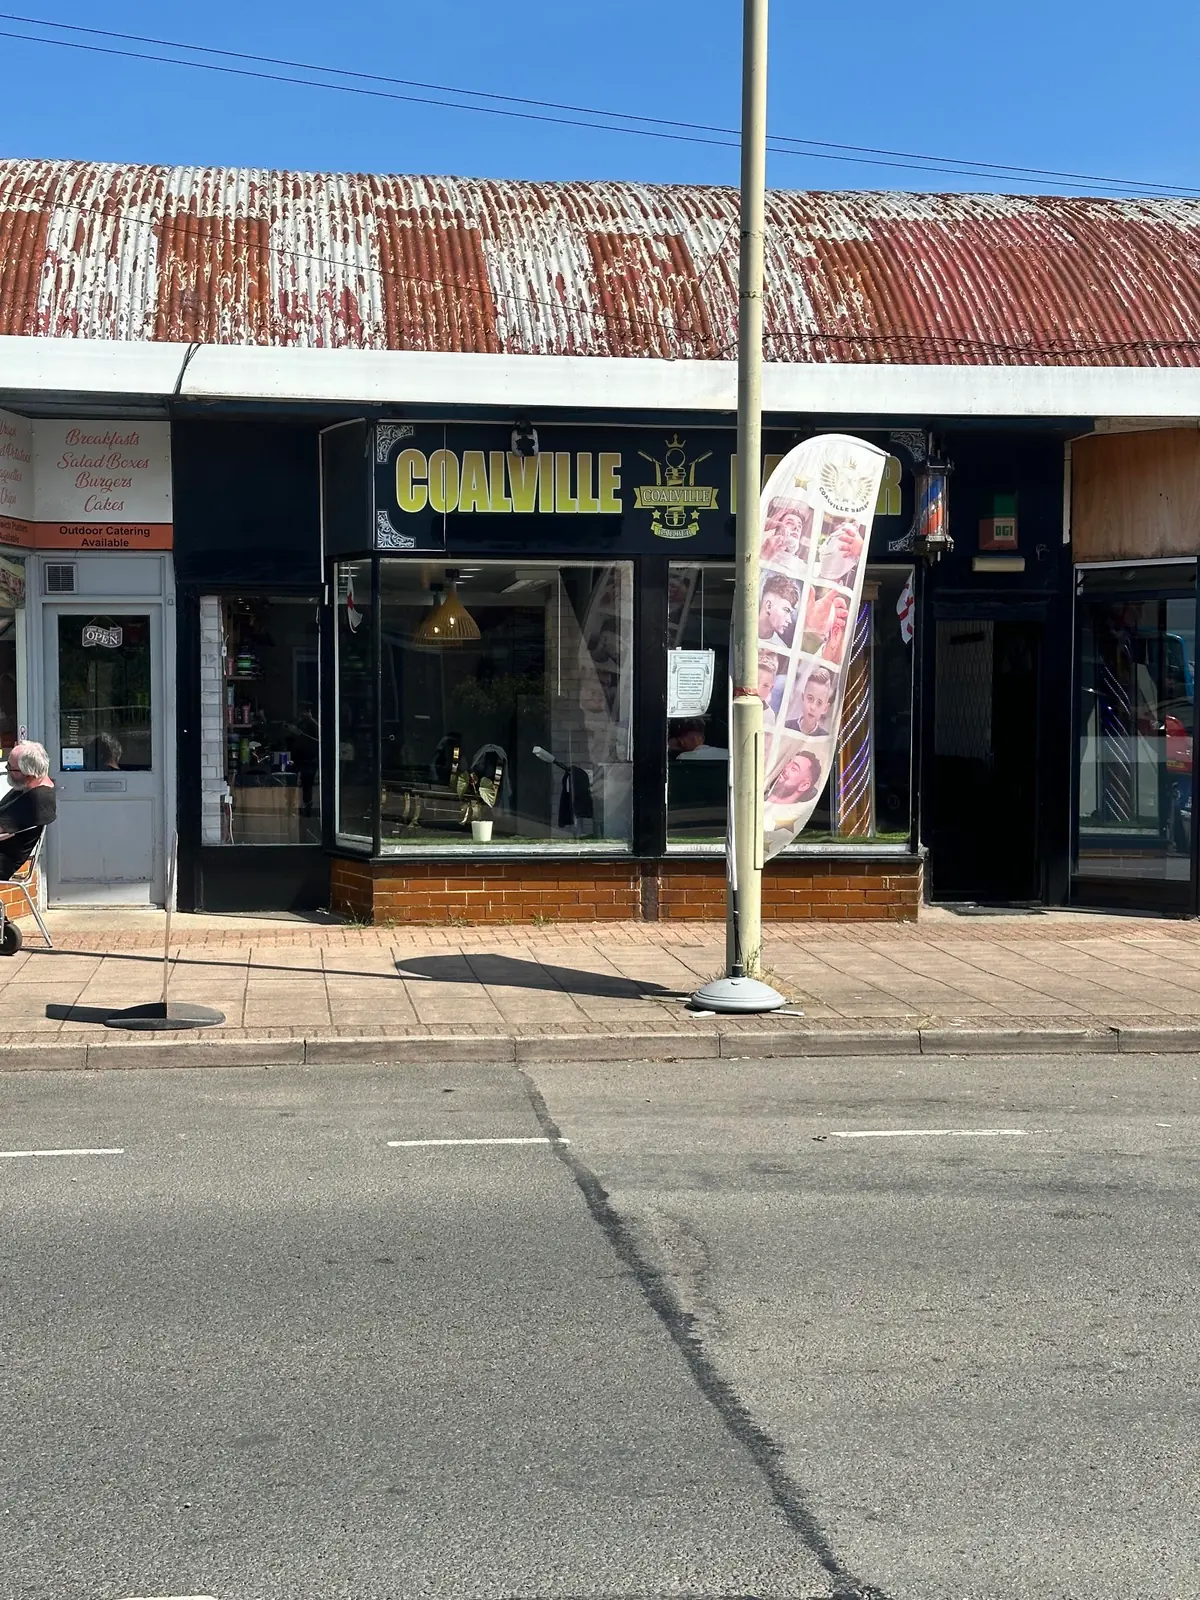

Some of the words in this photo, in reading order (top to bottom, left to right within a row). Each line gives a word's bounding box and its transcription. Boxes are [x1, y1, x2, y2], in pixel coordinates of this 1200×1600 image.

[65, 428, 140, 449] Breakfasts
[56, 451, 106, 470] Salad
[106, 451, 149, 470] Boxes
[75, 471, 133, 493] Burgers
[395, 448, 622, 514] COALVILLE
[84, 494, 125, 513] Cakes
[643, 489, 710, 502] COALVILLE
[819, 486, 849, 512] COALVILLE
[59, 525, 103, 536] Outdoor
[106, 525, 150, 537] Catering
[81, 538, 129, 548] Available
[86, 631, 118, 645] OPEN
